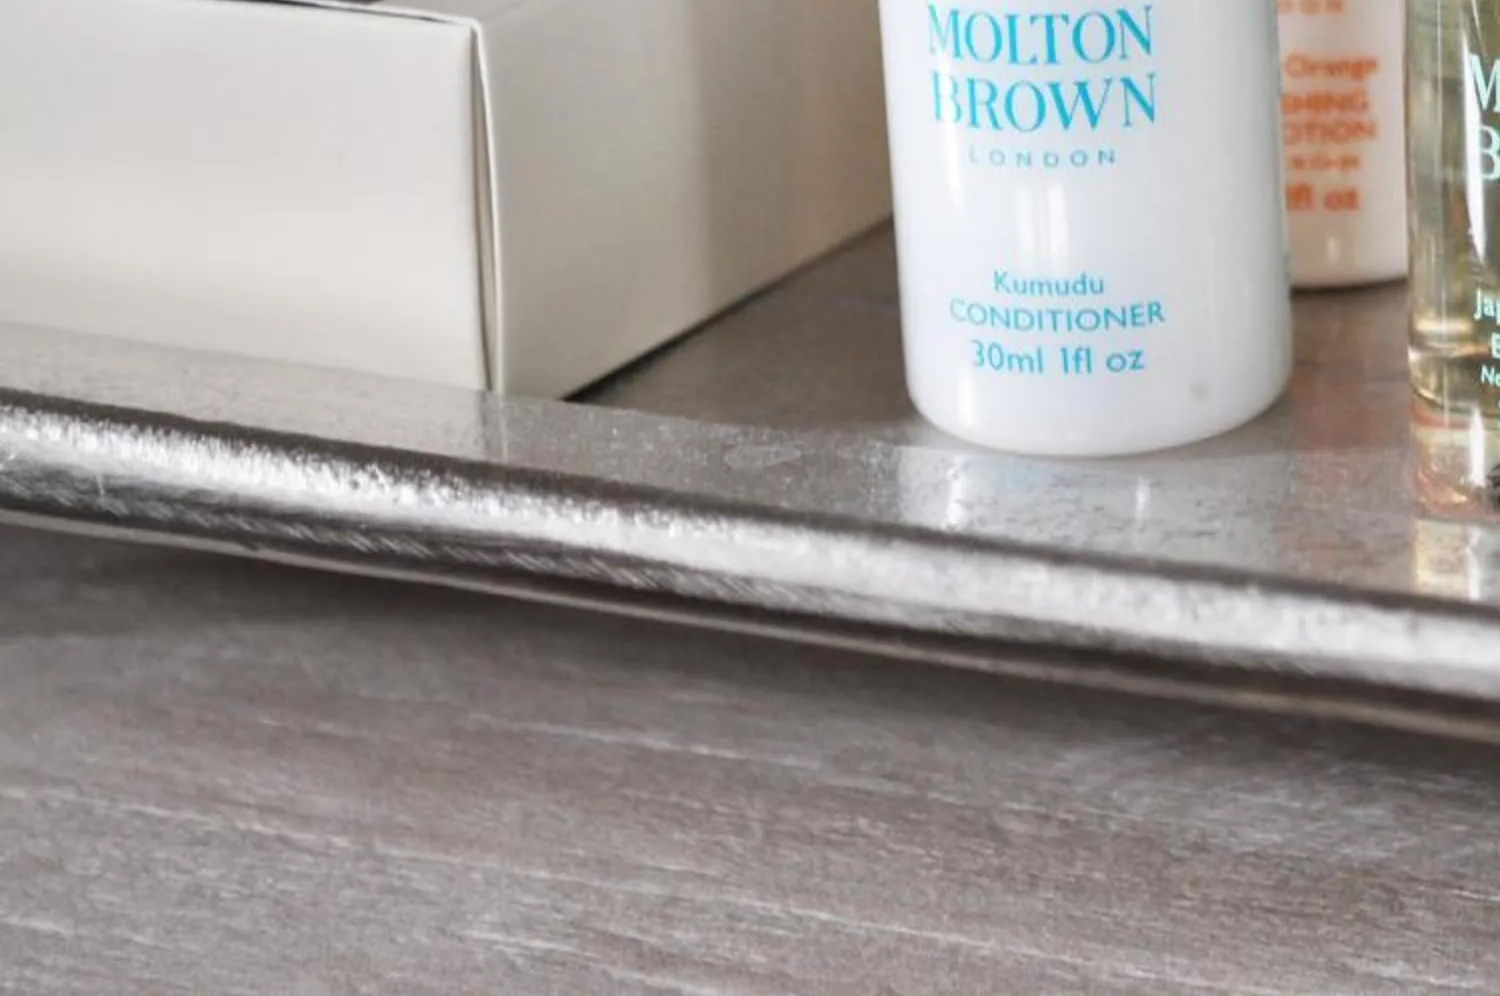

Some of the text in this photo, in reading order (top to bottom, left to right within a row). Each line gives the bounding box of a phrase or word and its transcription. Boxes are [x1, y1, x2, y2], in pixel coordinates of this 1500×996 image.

[927, 2, 1153, 66] MOLTON
[929, 69, 1157, 133] BROWN
[969, 146, 1117, 168] LONDON
[993, 268, 1106, 297] Kumudu
[949, 298, 1166, 333] CONDITIONER
[971, 339, 1045, 375] 30ml
[1105, 347, 1146, 373] oz
